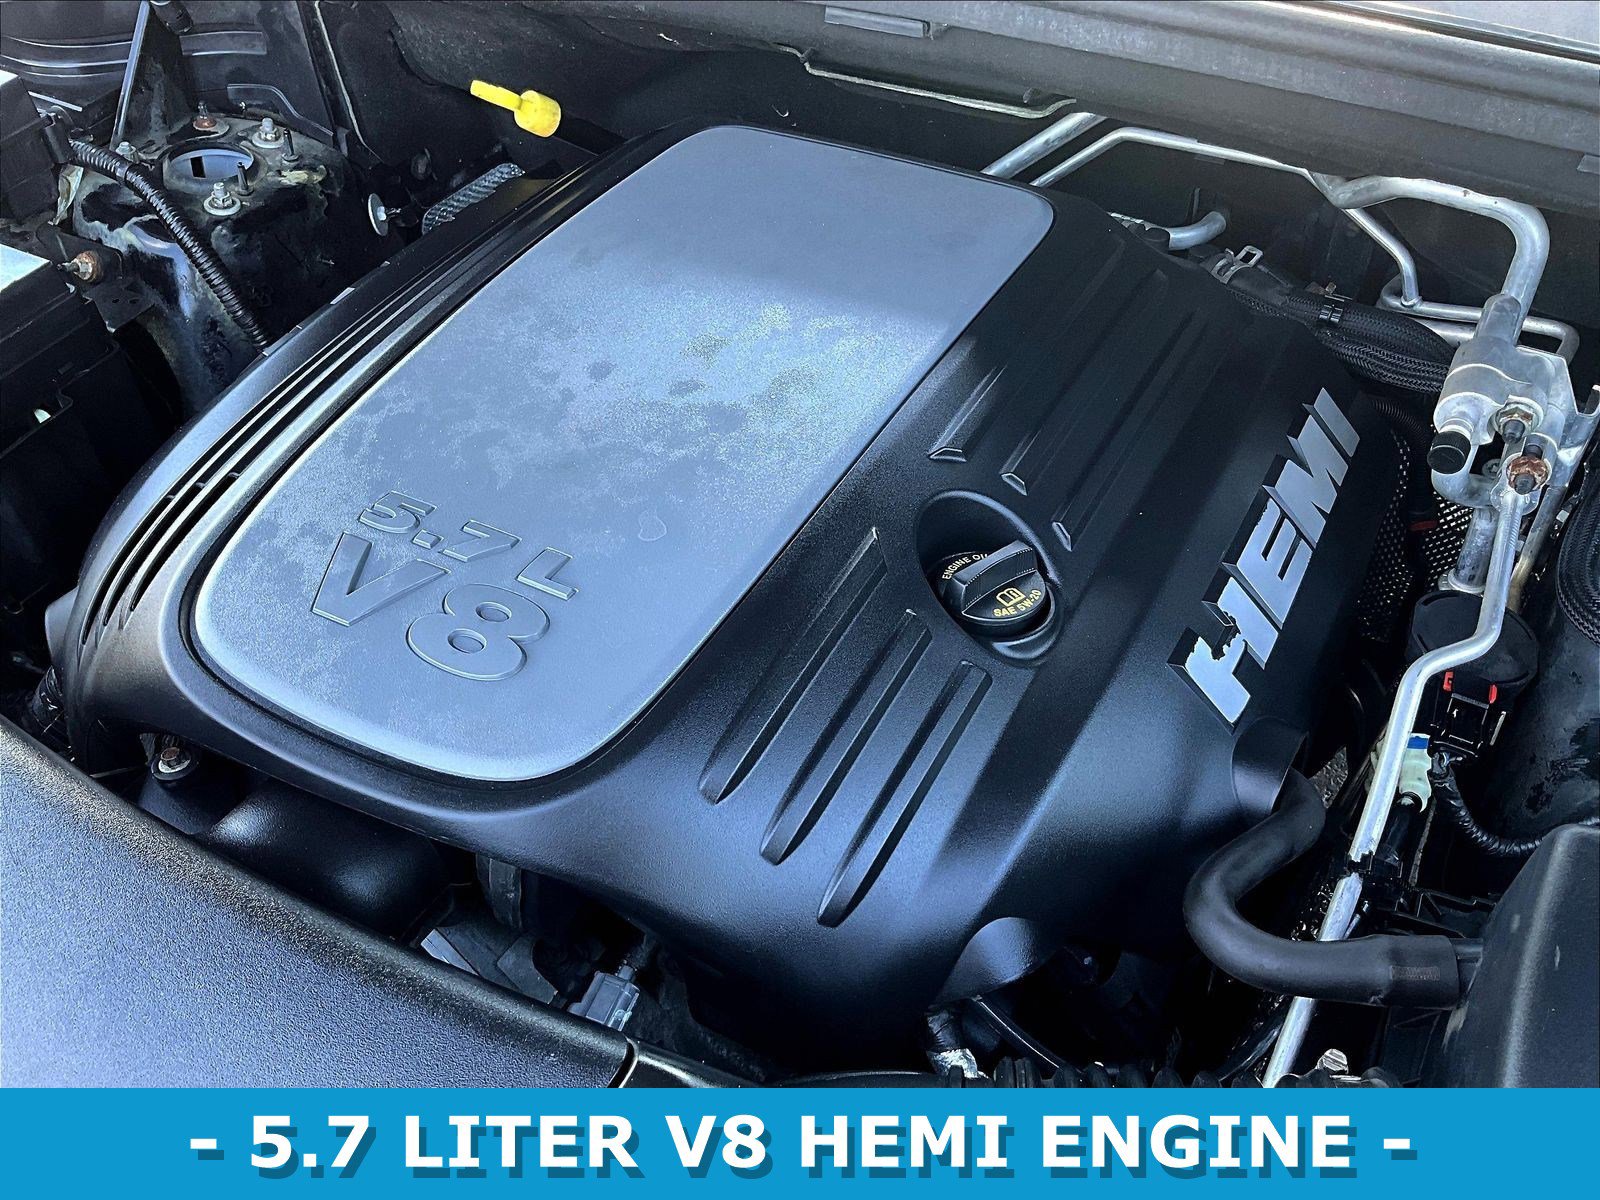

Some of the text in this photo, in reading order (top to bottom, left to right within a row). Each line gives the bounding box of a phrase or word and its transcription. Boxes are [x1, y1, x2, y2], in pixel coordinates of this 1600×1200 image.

[358, 490, 579, 601] 5.7 L
[941, 556, 972, 580] ENGINE
[1167, 387, 1360, 734] HEMI
[310, 530, 551, 682] V8
[993, 589, 1042, 617] SAE 5W-20
